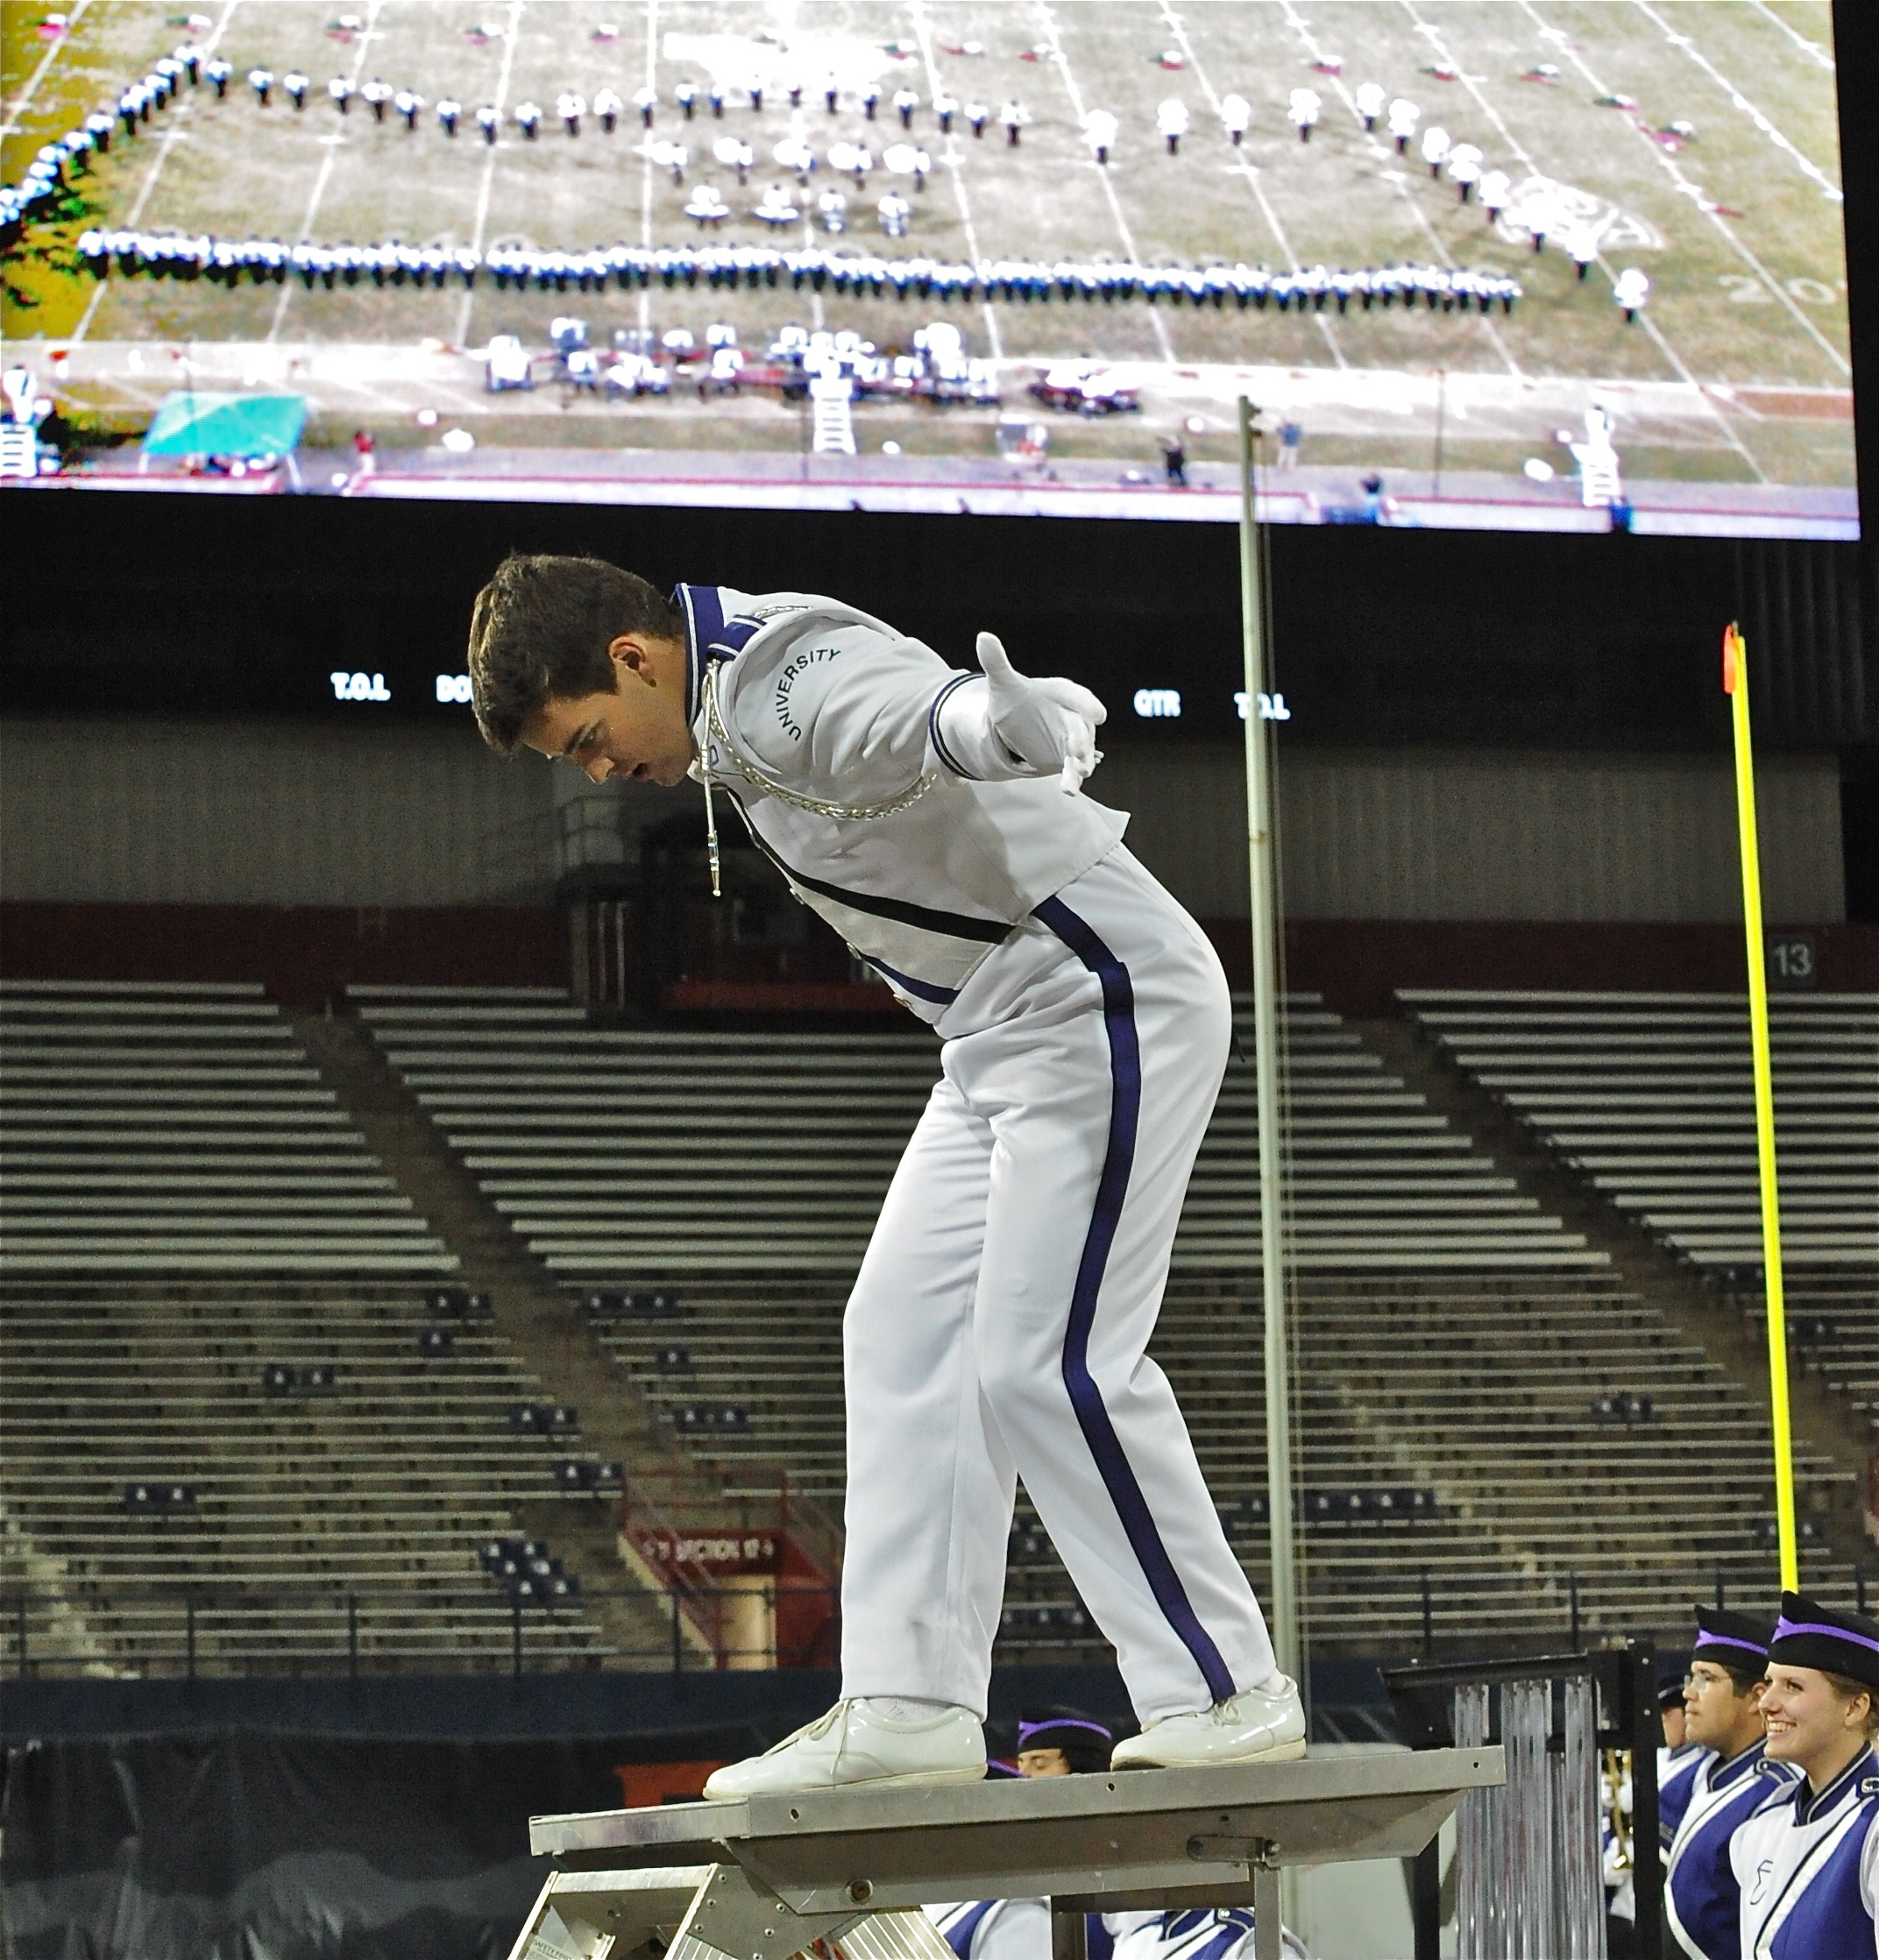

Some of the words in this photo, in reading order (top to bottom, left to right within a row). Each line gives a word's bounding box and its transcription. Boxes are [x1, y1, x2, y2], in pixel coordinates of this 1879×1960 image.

[776, 648, 841, 742] UNIVERSITY
[1134, 689, 1181, 717] QTR
[1775, 944, 1812, 977] 13
